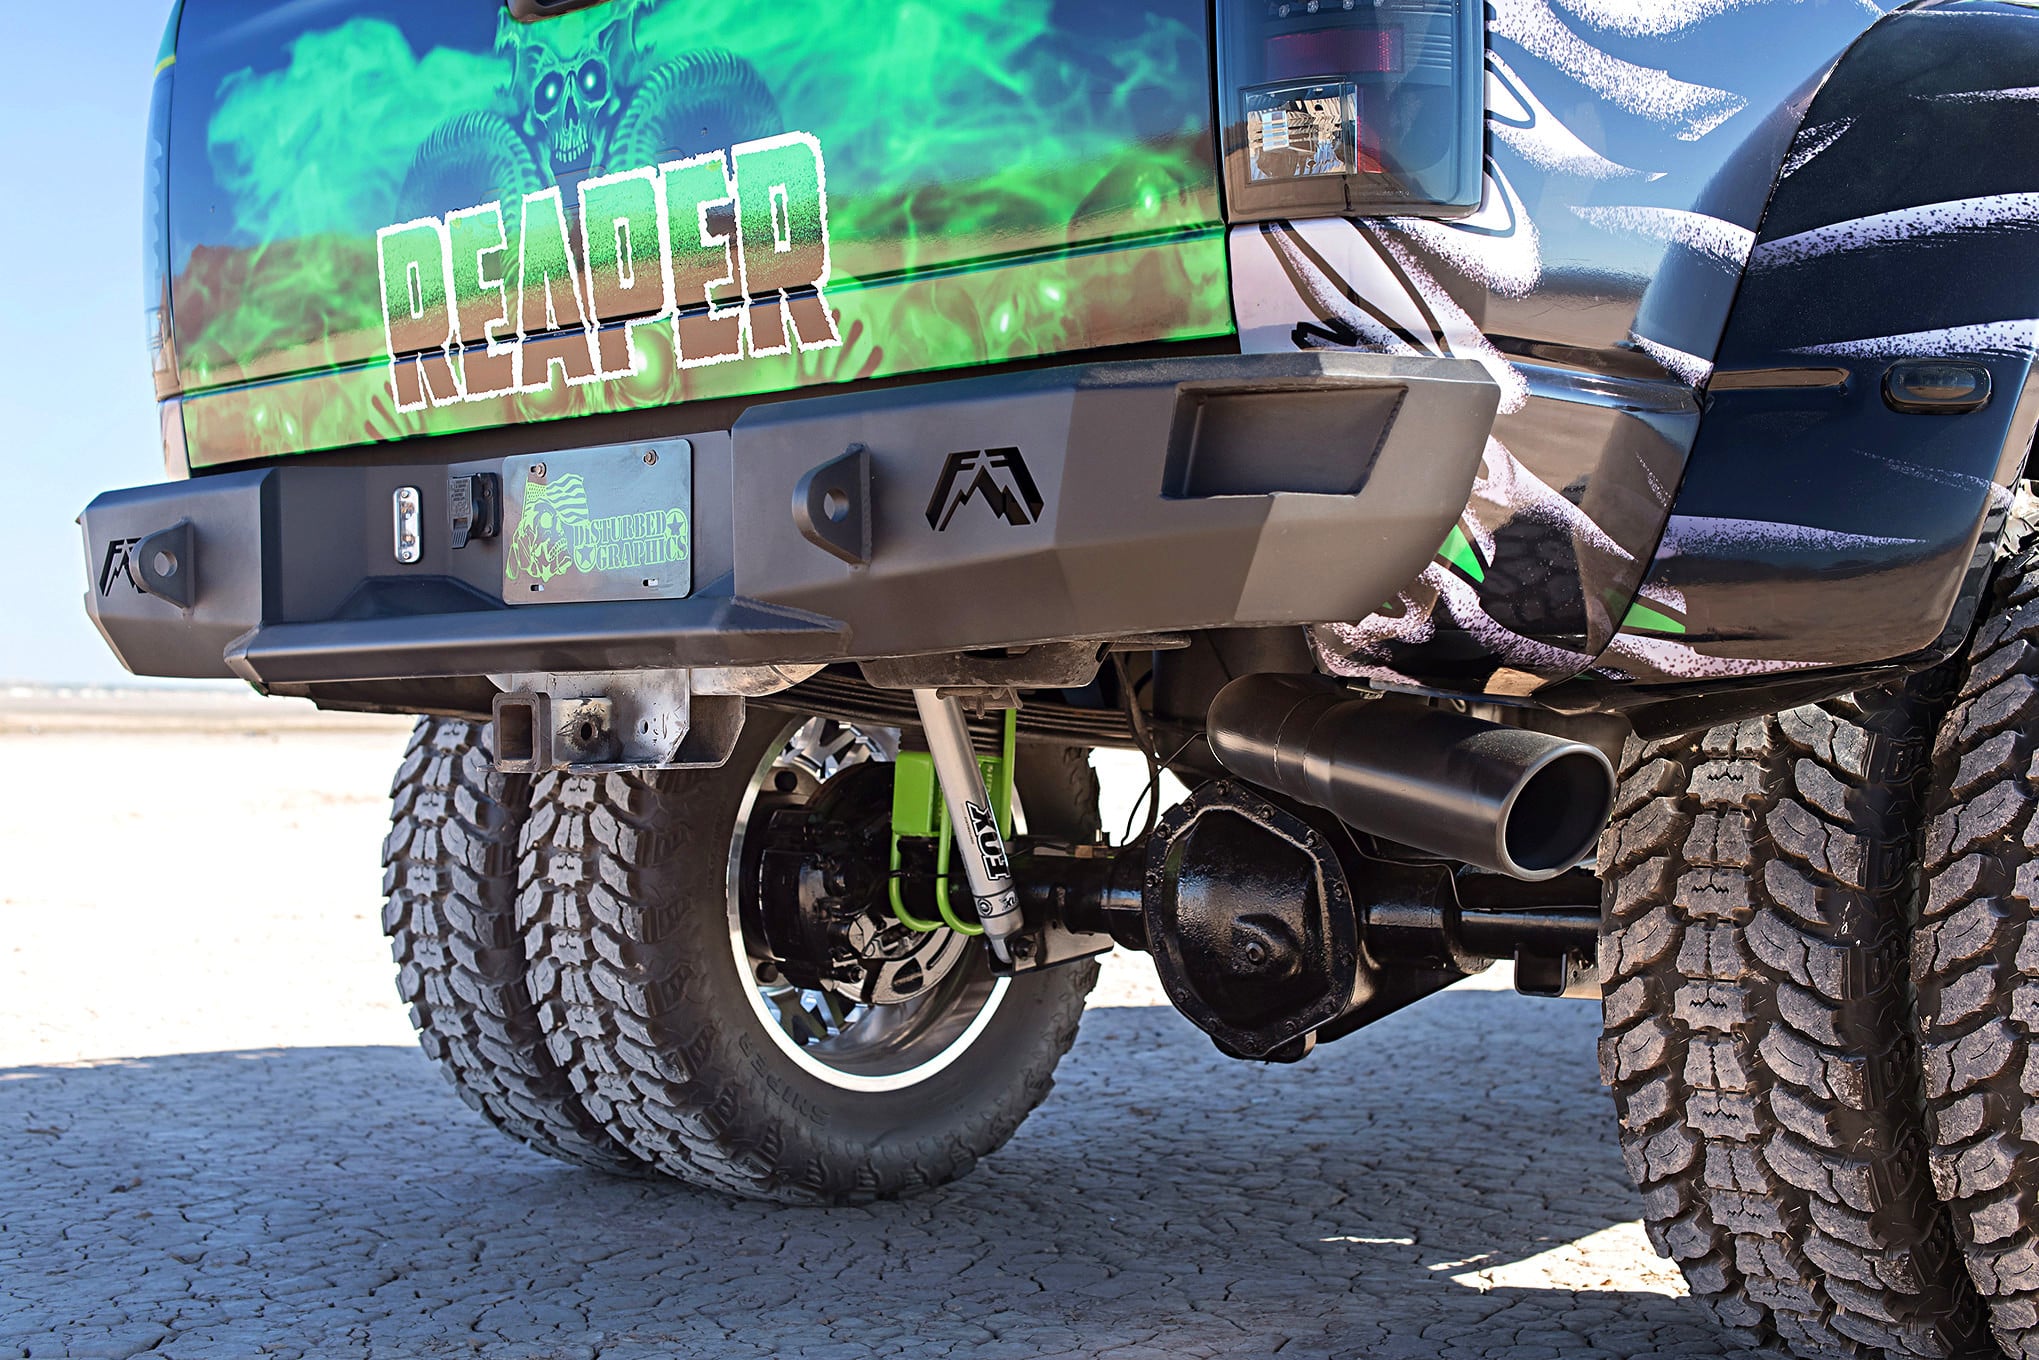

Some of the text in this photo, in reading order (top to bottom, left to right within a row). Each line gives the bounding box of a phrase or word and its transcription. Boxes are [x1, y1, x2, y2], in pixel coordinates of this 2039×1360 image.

[376, 130, 843, 414] REAPER
[573, 510, 667, 546] DISTURBED
[596, 535, 689, 571] GRAPHICS
[966, 800, 1012, 881] FOX
